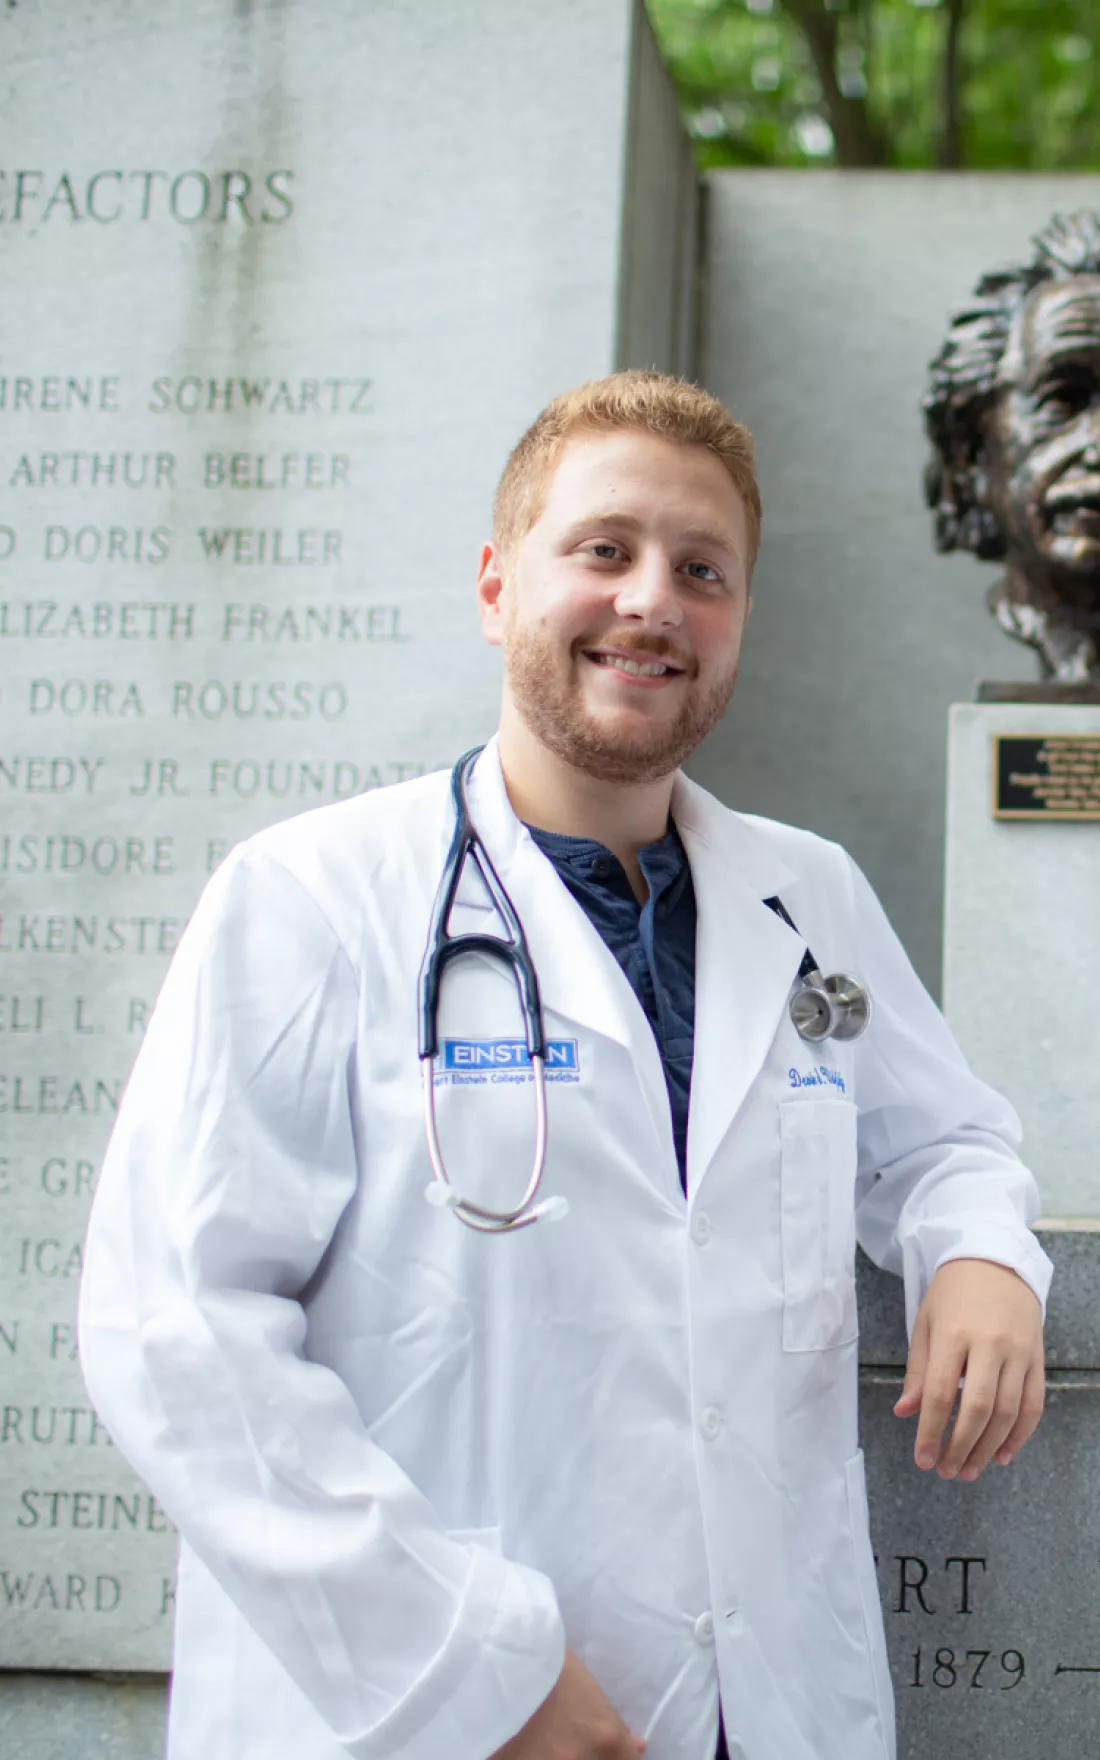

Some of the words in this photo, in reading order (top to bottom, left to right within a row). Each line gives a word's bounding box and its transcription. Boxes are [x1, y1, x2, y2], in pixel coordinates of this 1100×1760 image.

[0, 170, 295, 226] FACTORS
[0, 376, 119, 412] IRENE
[148, 376, 374, 414] SCHWARTZ
[9, 451, 177, 489] ARTHUR
[203, 452, 351, 490] BELFER
[44, 525, 171, 565] DORIS
[199, 527, 344, 566] WEILER
[0, 602, 194, 638] LIZABETH
[222, 603, 411, 642] FRANKEL
[29, 679, 144, 717] DORA
[173, 680, 348, 720] ROUSSO
[210, 760, 455, 797] FOUNDAT
[2, 836, 174, 874] ISIDORE
[0, 914, 191, 953] LKENSTE
[0, 993, 46, 1034] LI
[454, 1043, 568, 1064] EINSTN
[17, 1489, 177, 1534] STEINE
[874, 1556, 986, 1615] RT
[910, 1646, 1026, 1690] 1879
